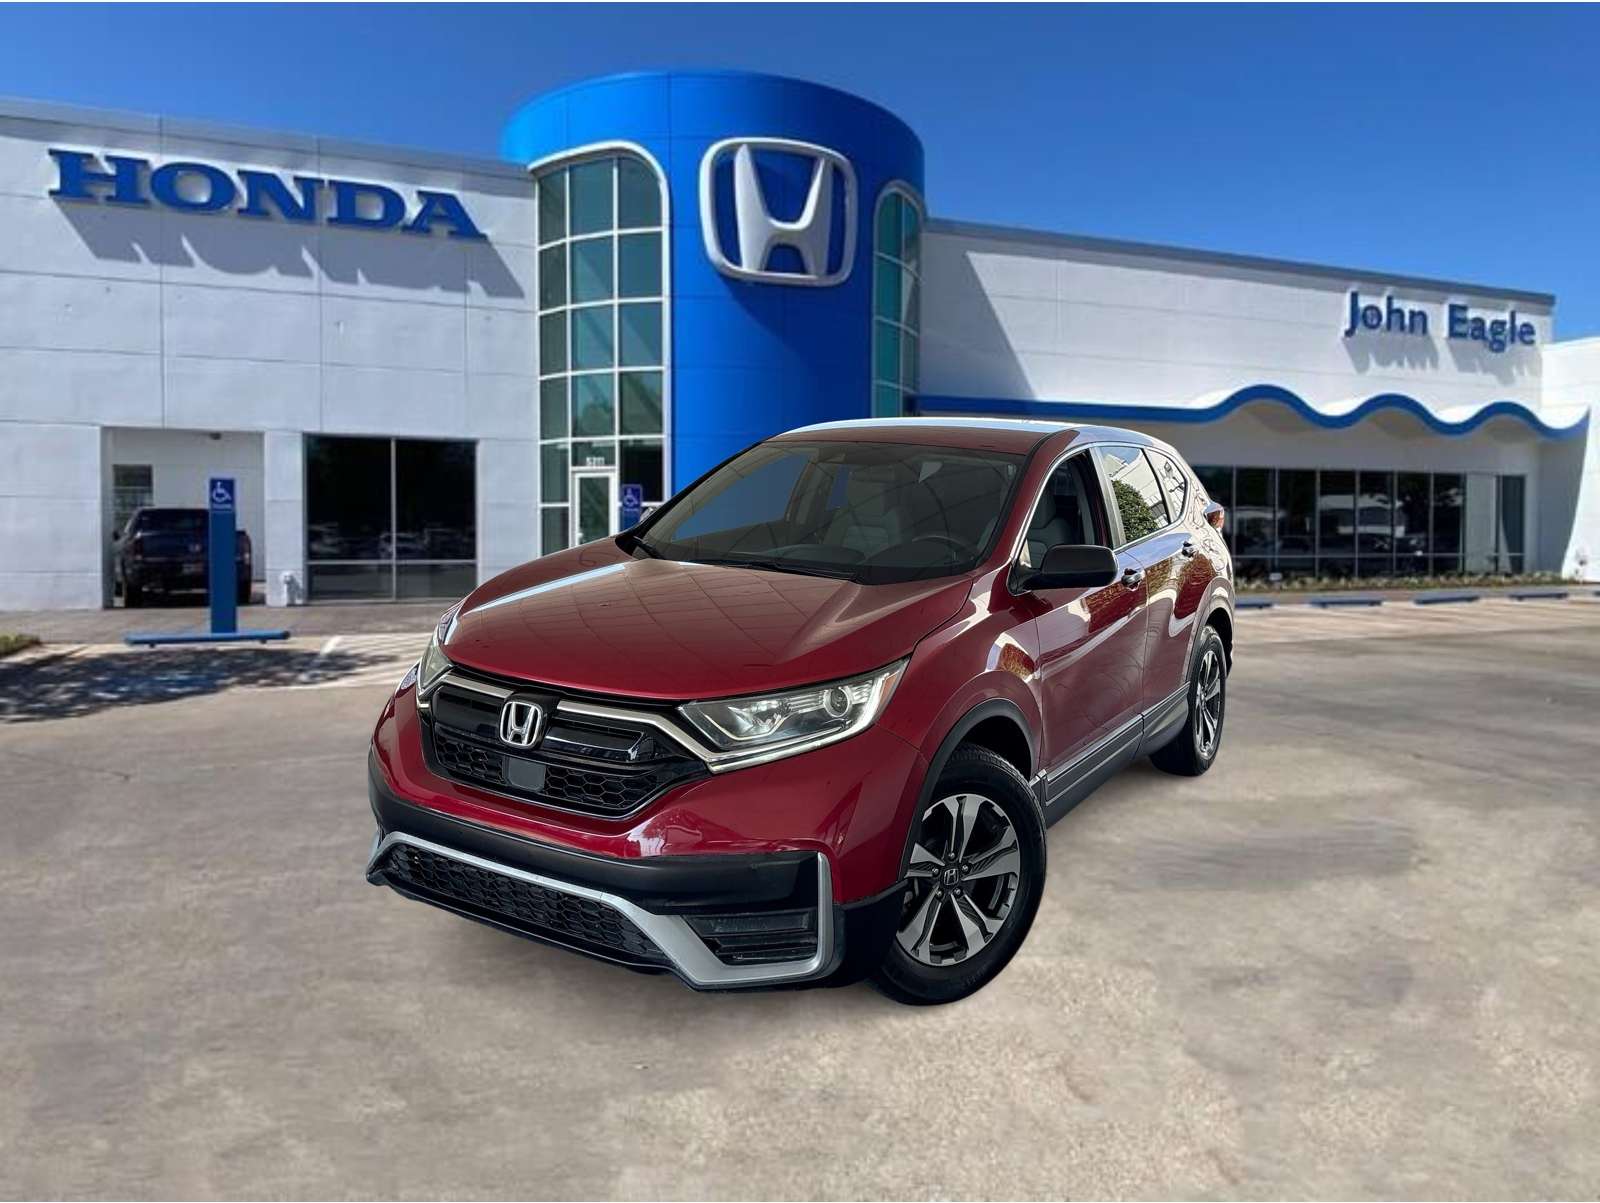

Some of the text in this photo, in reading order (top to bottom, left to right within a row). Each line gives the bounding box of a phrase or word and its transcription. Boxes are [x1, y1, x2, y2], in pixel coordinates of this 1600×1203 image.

[47, 148, 488, 241] HONDA
[1344, 291, 1536, 353] John Eagle
